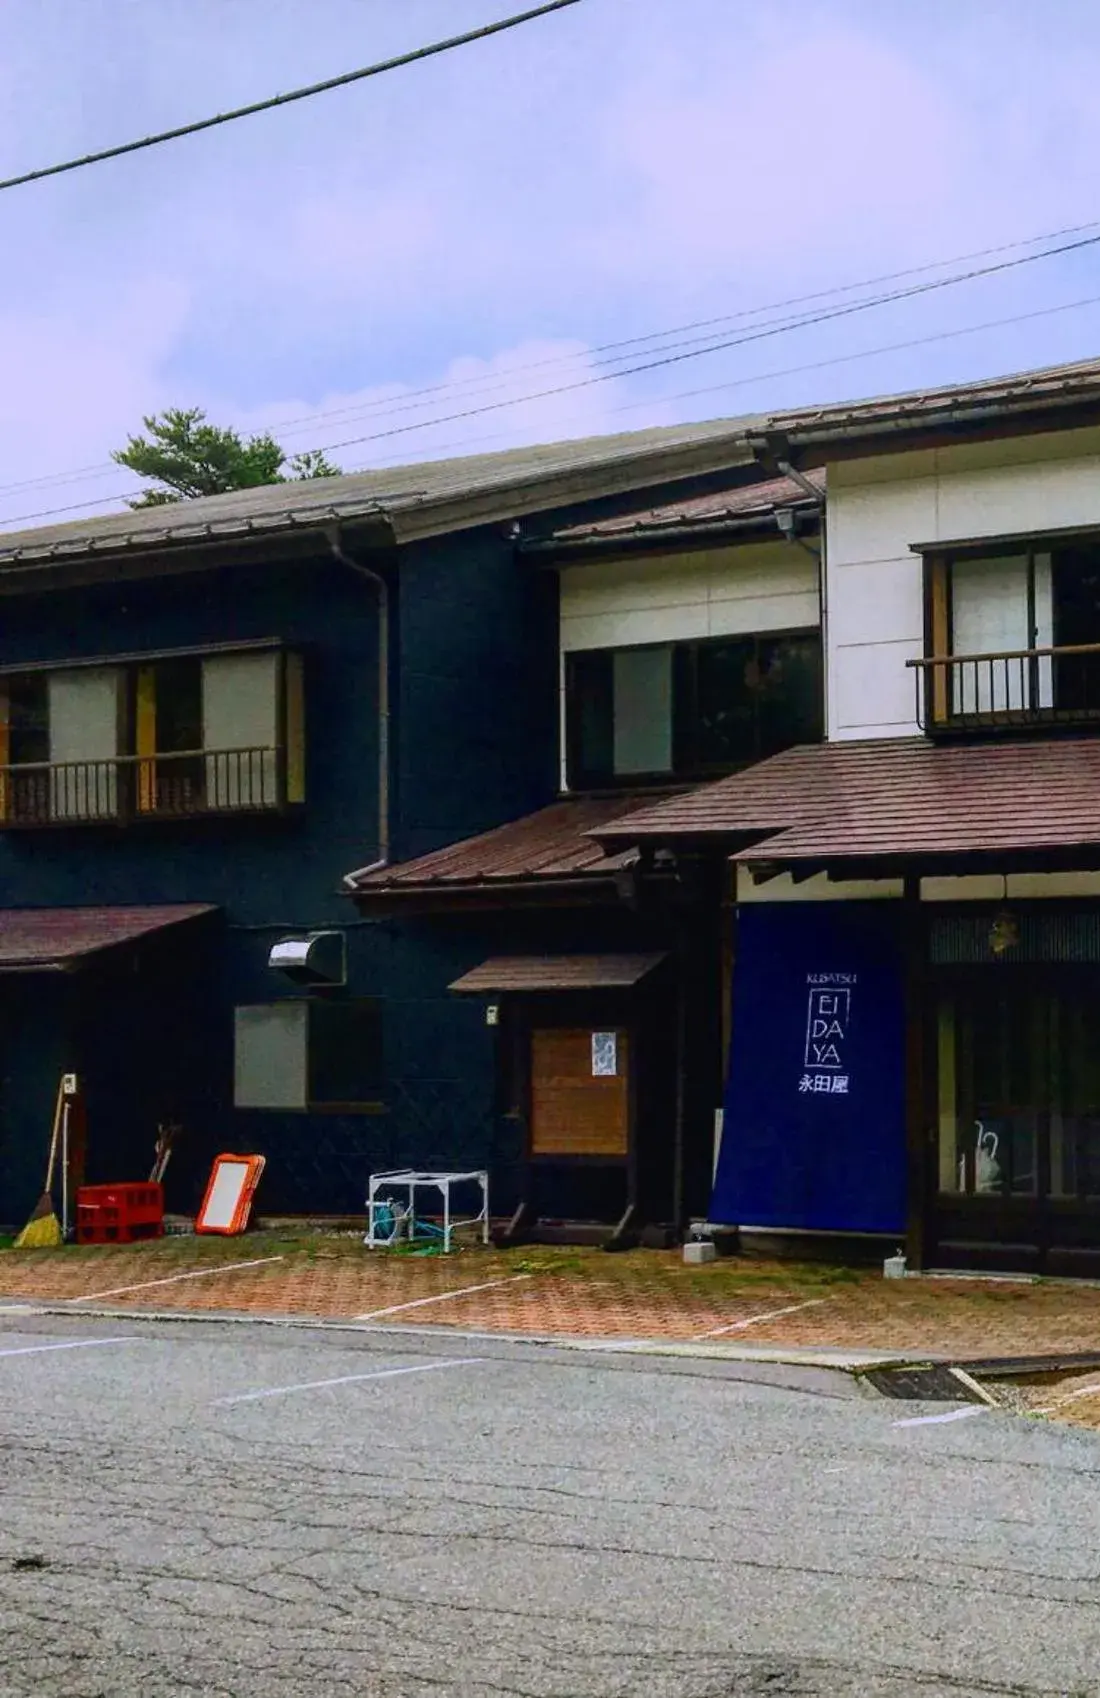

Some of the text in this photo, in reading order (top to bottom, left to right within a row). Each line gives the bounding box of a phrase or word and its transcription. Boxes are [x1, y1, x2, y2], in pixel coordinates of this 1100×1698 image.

[818, 995, 838, 1014] EI
[812, 1019, 844, 1039] DA
[812, 1043, 841, 1063] YA
[798, 1074, 849, 1093] 永田屋
